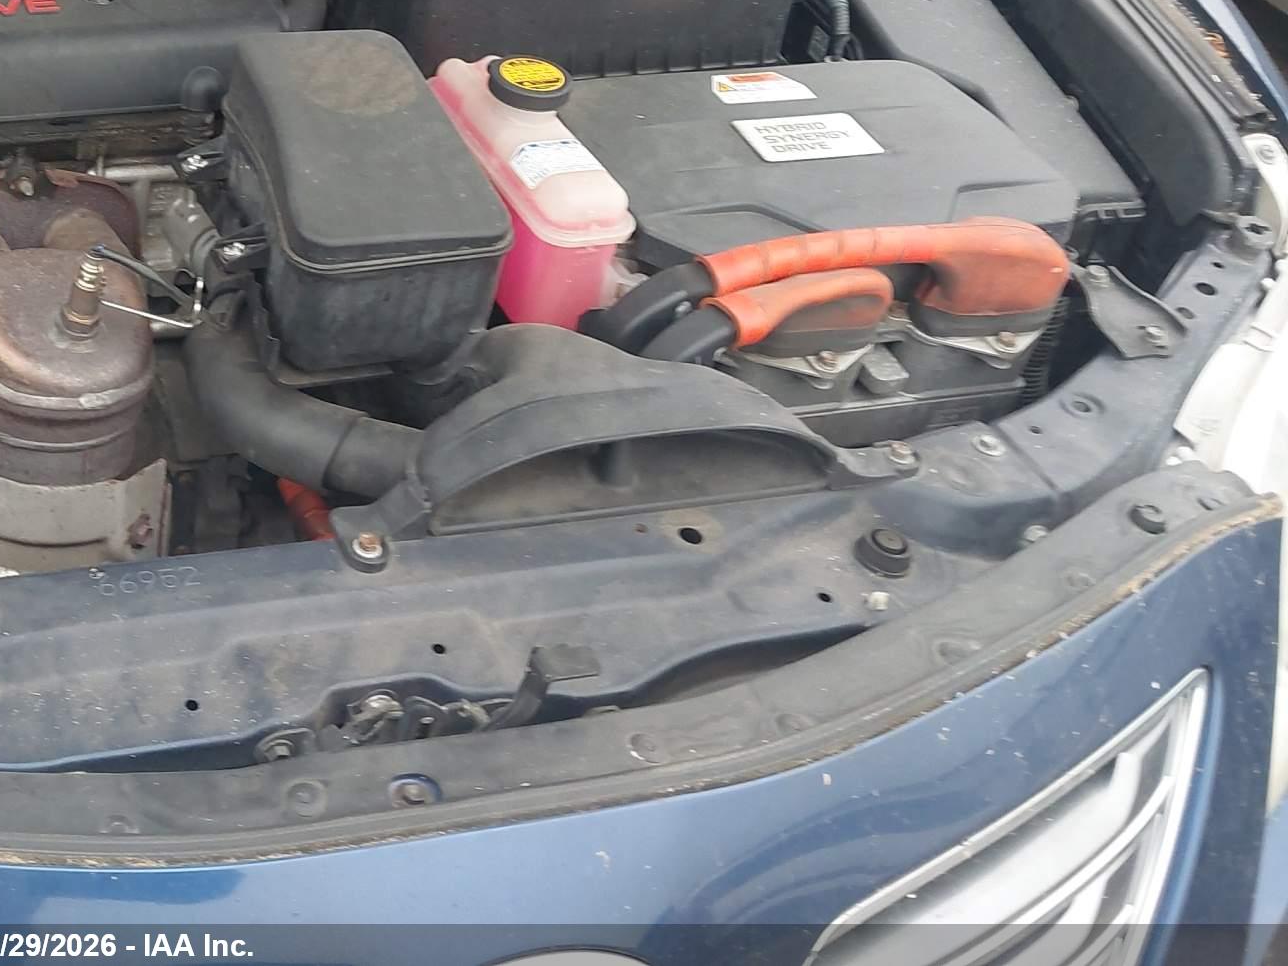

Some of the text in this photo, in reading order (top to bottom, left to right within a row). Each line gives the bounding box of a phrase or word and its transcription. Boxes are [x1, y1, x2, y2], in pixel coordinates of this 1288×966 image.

[754, 121, 827, 135] HYBRID
[761, 130, 851, 144] SYNERGY
[771, 142, 832, 153] DRIVE
